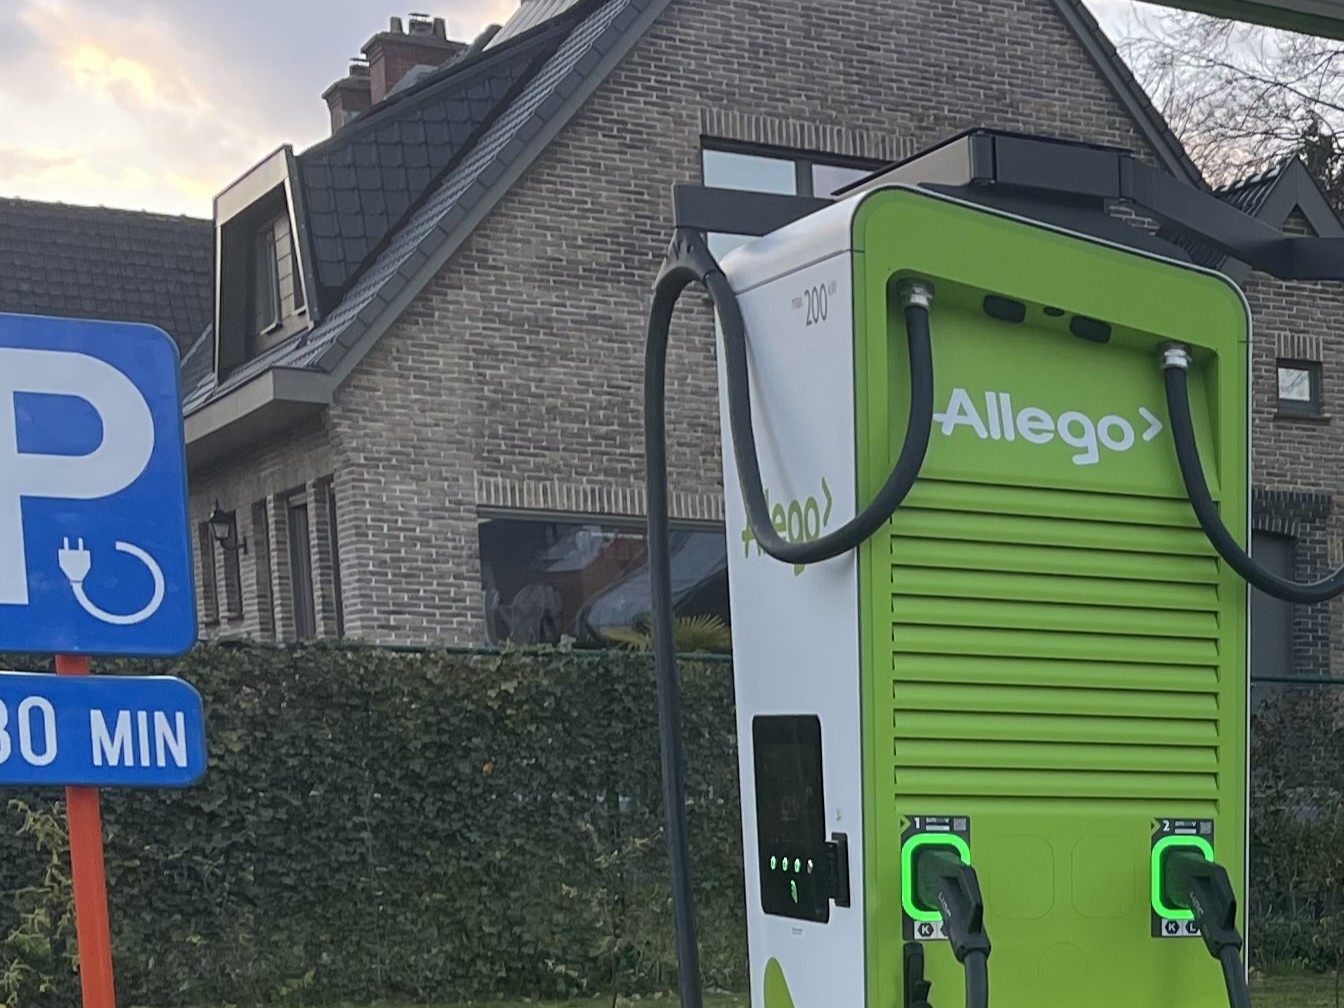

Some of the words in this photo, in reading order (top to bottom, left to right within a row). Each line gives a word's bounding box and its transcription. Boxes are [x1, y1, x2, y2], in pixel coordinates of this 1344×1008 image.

[804, 283, 828, 327] 200
[933, 388, 1135, 466] Allego
[0, 348, 155, 606] P
[741, 488, 821, 576] ego
[90, 709, 188, 769] MIN
[913, 817, 921, 830] 1
[1162, 820, 1171, 832] 2
[921, 925, 930, 935] K
[1168, 923, 1176, 932] K
